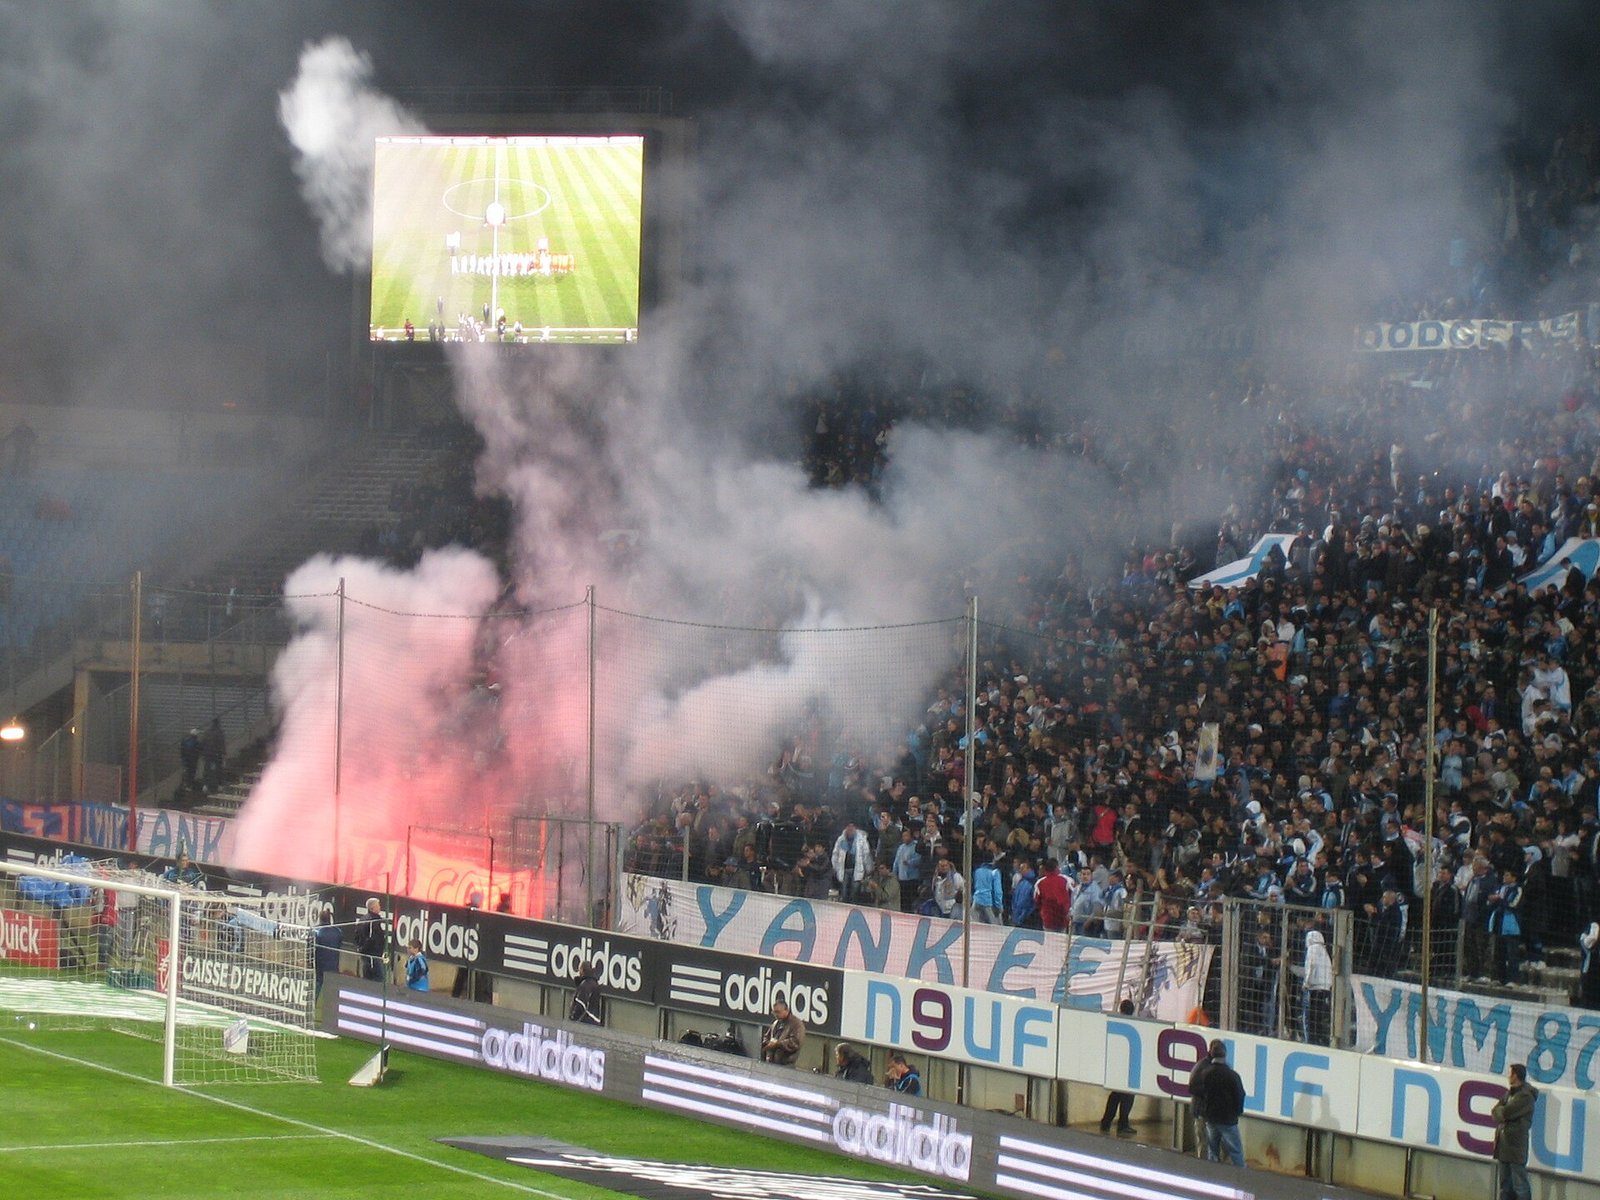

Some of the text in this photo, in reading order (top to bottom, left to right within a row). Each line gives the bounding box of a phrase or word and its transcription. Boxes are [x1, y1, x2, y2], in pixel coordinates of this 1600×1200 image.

[396, 909, 479, 962] adidas
[550, 937, 642, 993] adidas
[696, 884, 1113, 1011] YANKEE
[183, 955, 309, 1007] CAISSE D'EPARGNE
[724, 966, 829, 1026] adidas
[482, 1022, 605, 1091] adidas
[1362, 982, 1600, 1091] YNM 87
